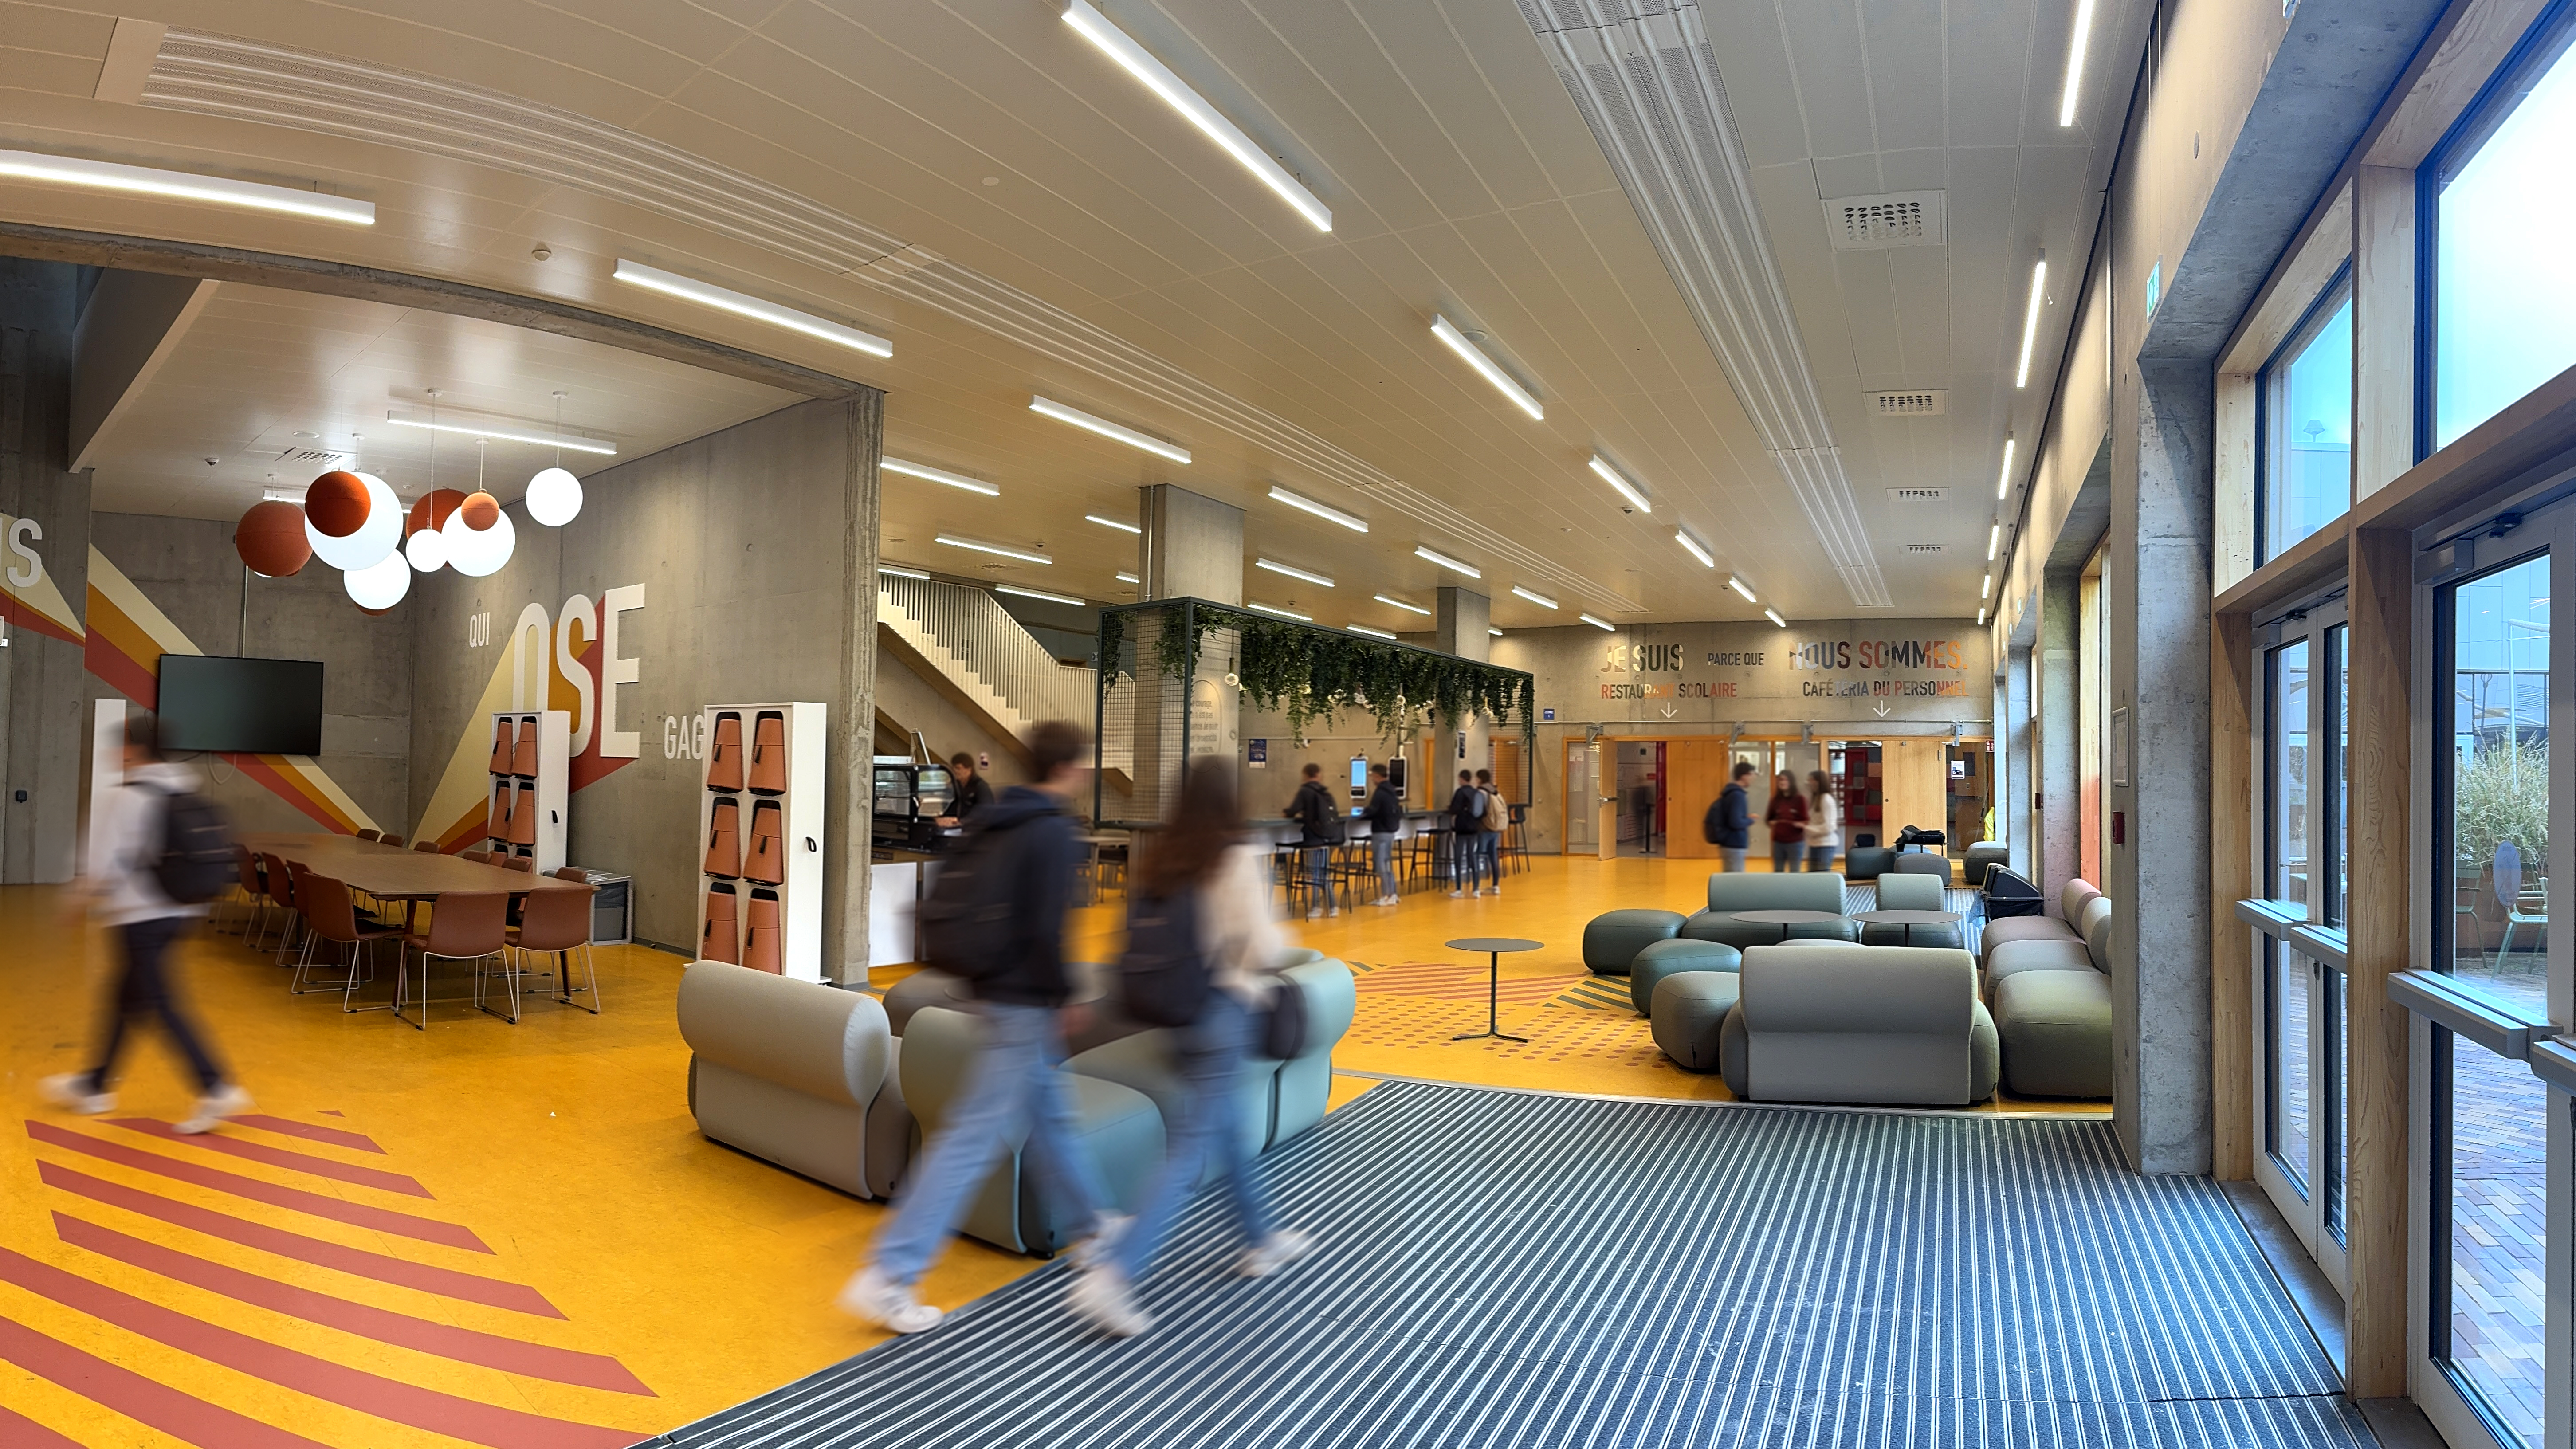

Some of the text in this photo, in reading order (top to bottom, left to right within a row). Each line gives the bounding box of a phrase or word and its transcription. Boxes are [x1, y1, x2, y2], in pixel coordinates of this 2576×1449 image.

[0, 517, 42, 588] S
[469, 583, 704, 760] QUI OSE GAG
[1600, 640, 1968, 673] JE SUIS PARCE QUE NOUS SOMMES.
[1601, 682, 1737, 699] RESTAURANT SCOLAIRE
[1802, 678, 1969, 697] CAFÉTÉRIA DU PERSONNEL
